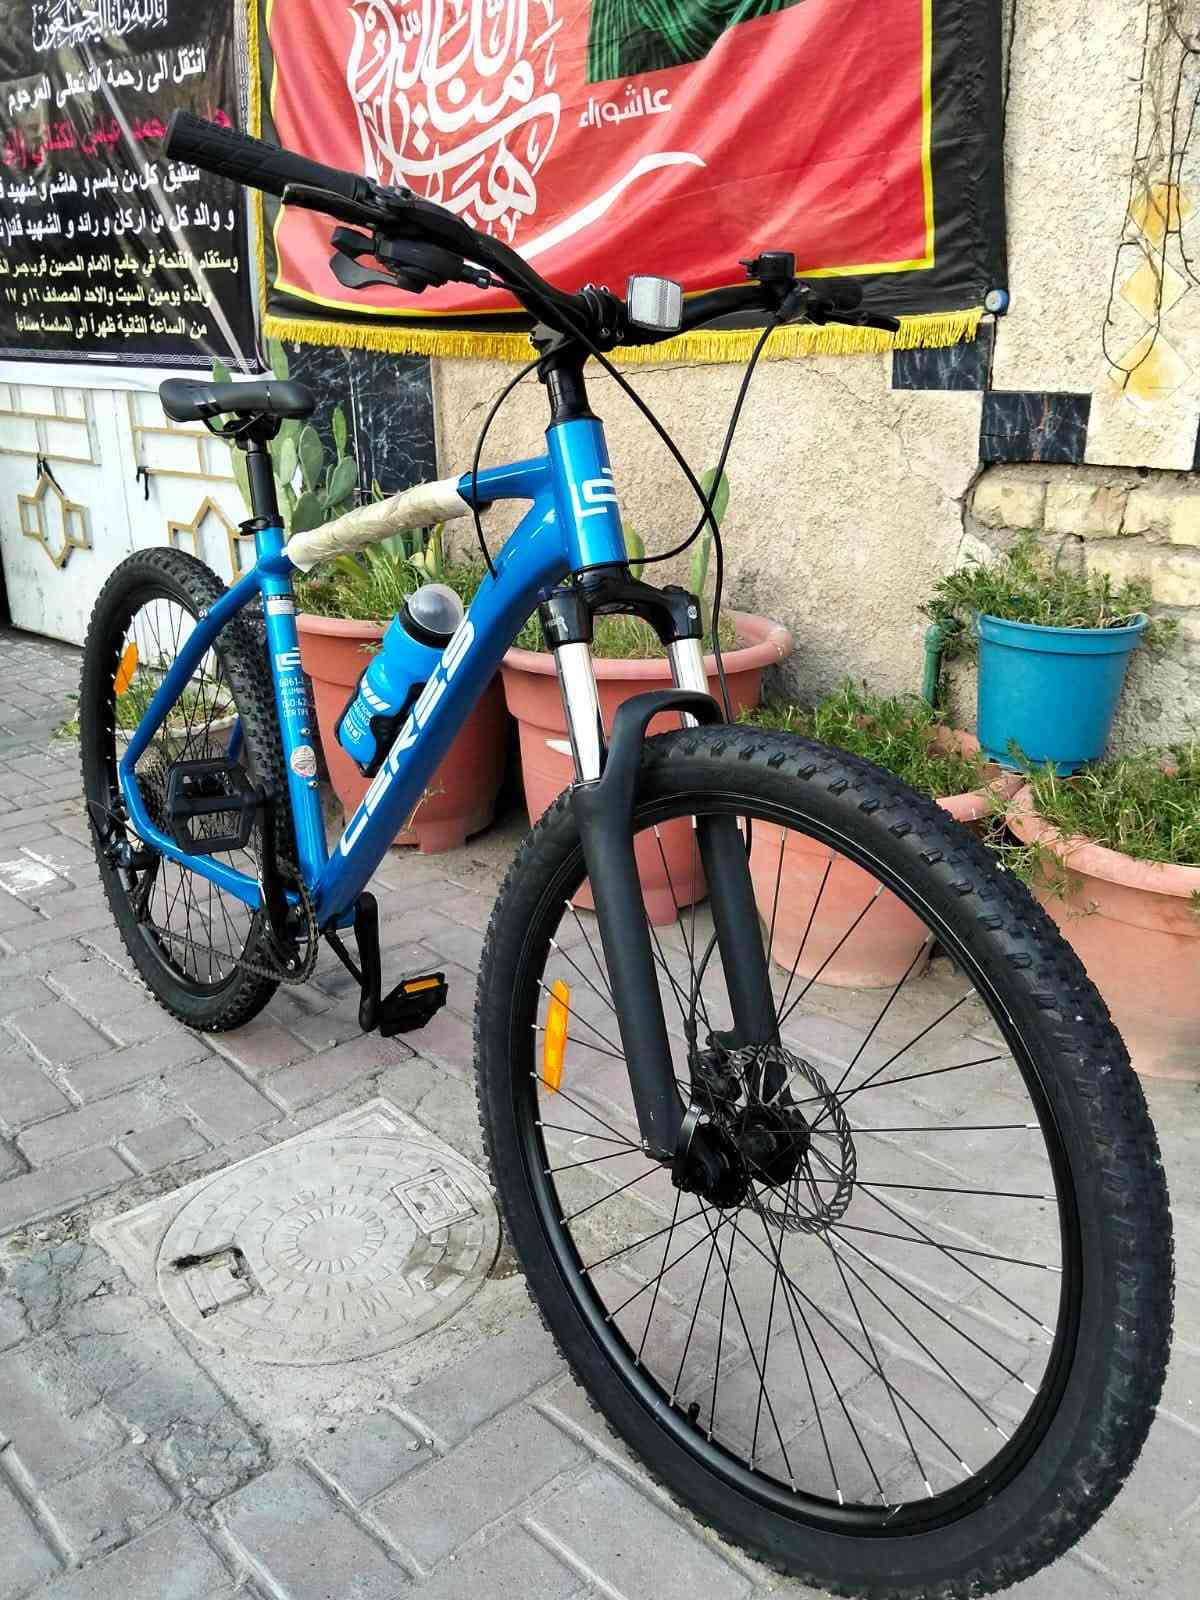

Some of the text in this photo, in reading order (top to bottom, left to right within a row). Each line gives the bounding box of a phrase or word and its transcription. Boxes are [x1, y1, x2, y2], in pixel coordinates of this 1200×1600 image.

[106, 58, 144, 92] رحمة
[172, 47, 207, 84] انتقل
[7, 75, 51, 117] المرحوم
[578, 84, 673, 129] عاشوراء
[49, 171, 78, 204] هاشم
[92, 167, 119, 200] باسم
[140, 161, 159, 190] كل
[25, 211, 62, 241] الشهيد
[151, 209, 165, 234] من
[168, 203, 190, 233] كل
[193, 200, 220, 232] والد
[49, 253, 85, 276] الحسين
[114, 253, 139, 278] جامع
[141, 248, 156, 277] في
[115, 284, 145, 306] السبت
[149, 313, 186, 334] الساعة
[189, 320, 208, 339] من
[339, 620, 475, 857] CERES
